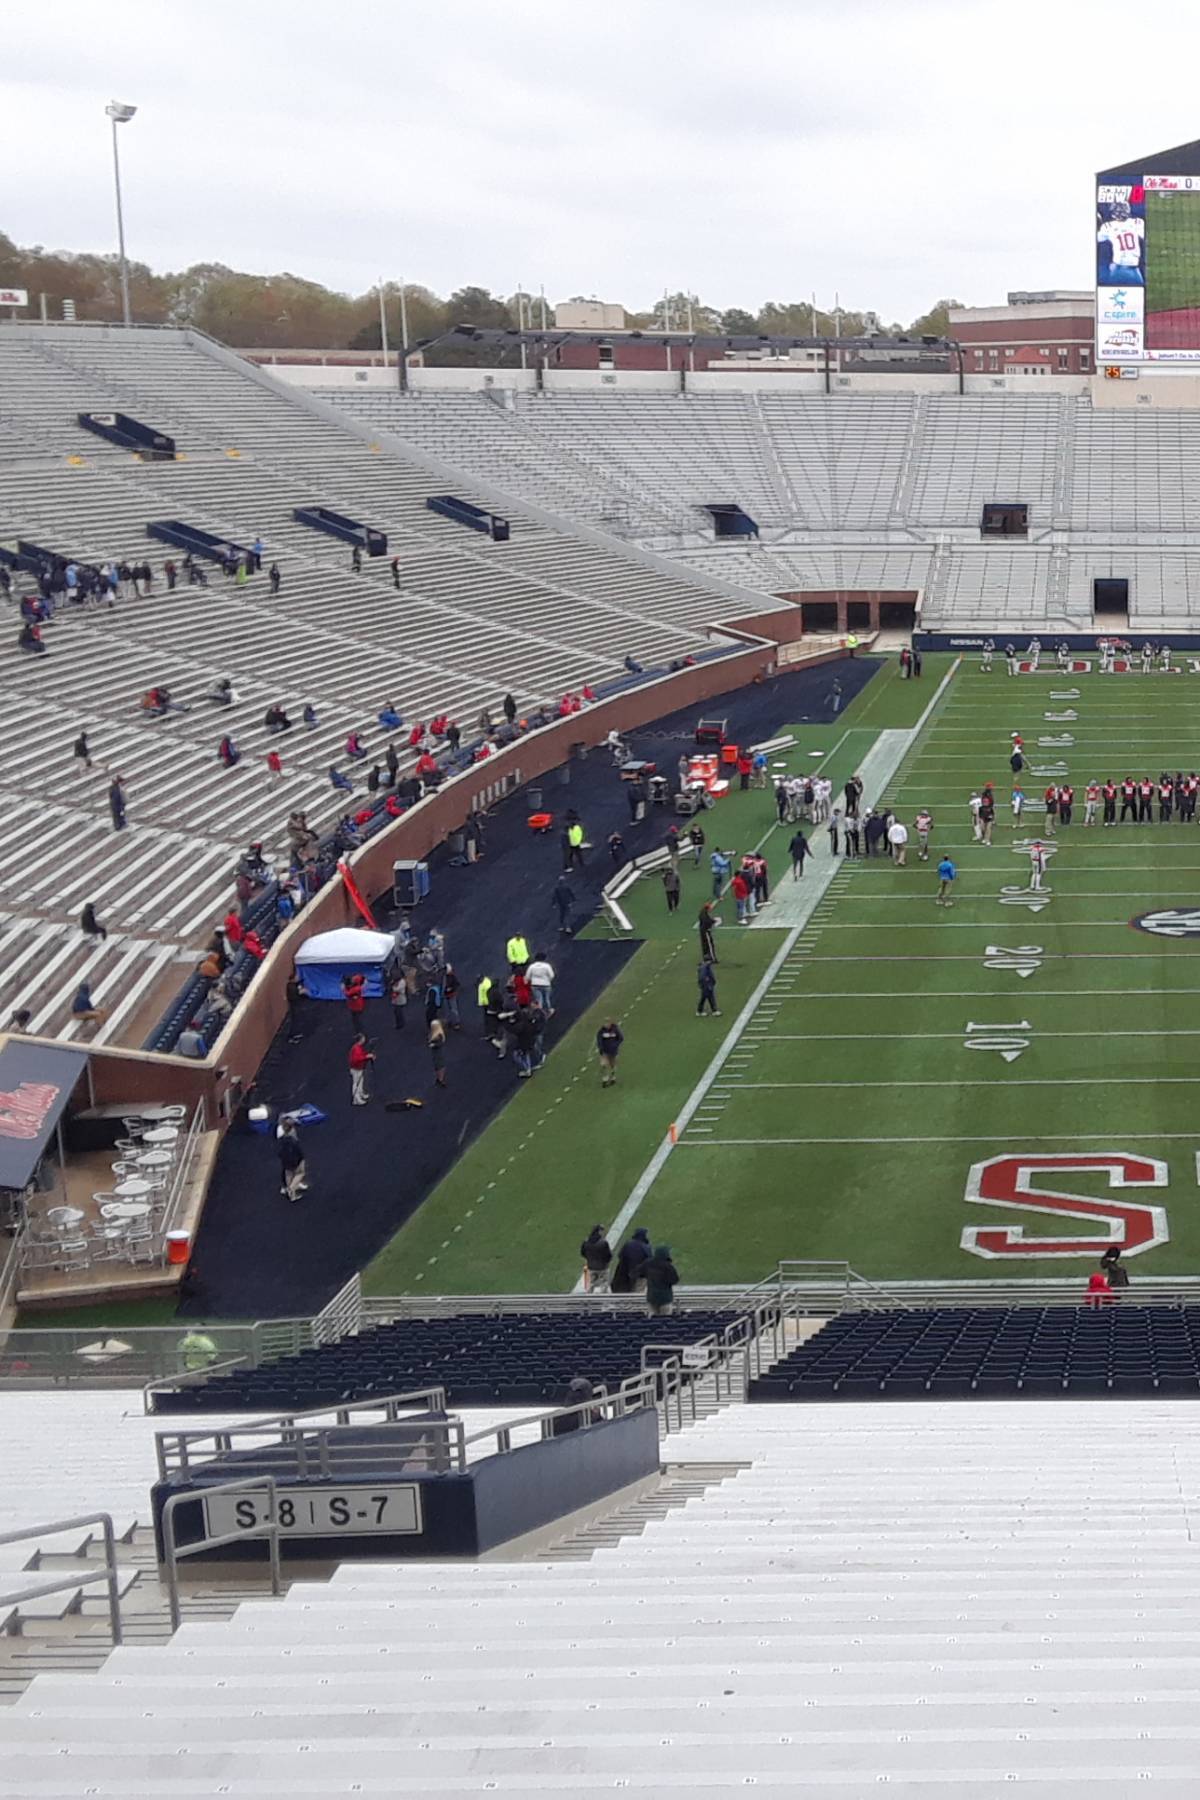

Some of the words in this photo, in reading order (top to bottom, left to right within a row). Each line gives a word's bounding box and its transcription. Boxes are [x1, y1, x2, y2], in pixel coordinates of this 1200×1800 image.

[1116, 232, 1136, 251] 10
[982, 944, 1044, 969] 20
[962, 1019, 1033, 1051] 10
[328, 1496, 389, 1526] S-7
